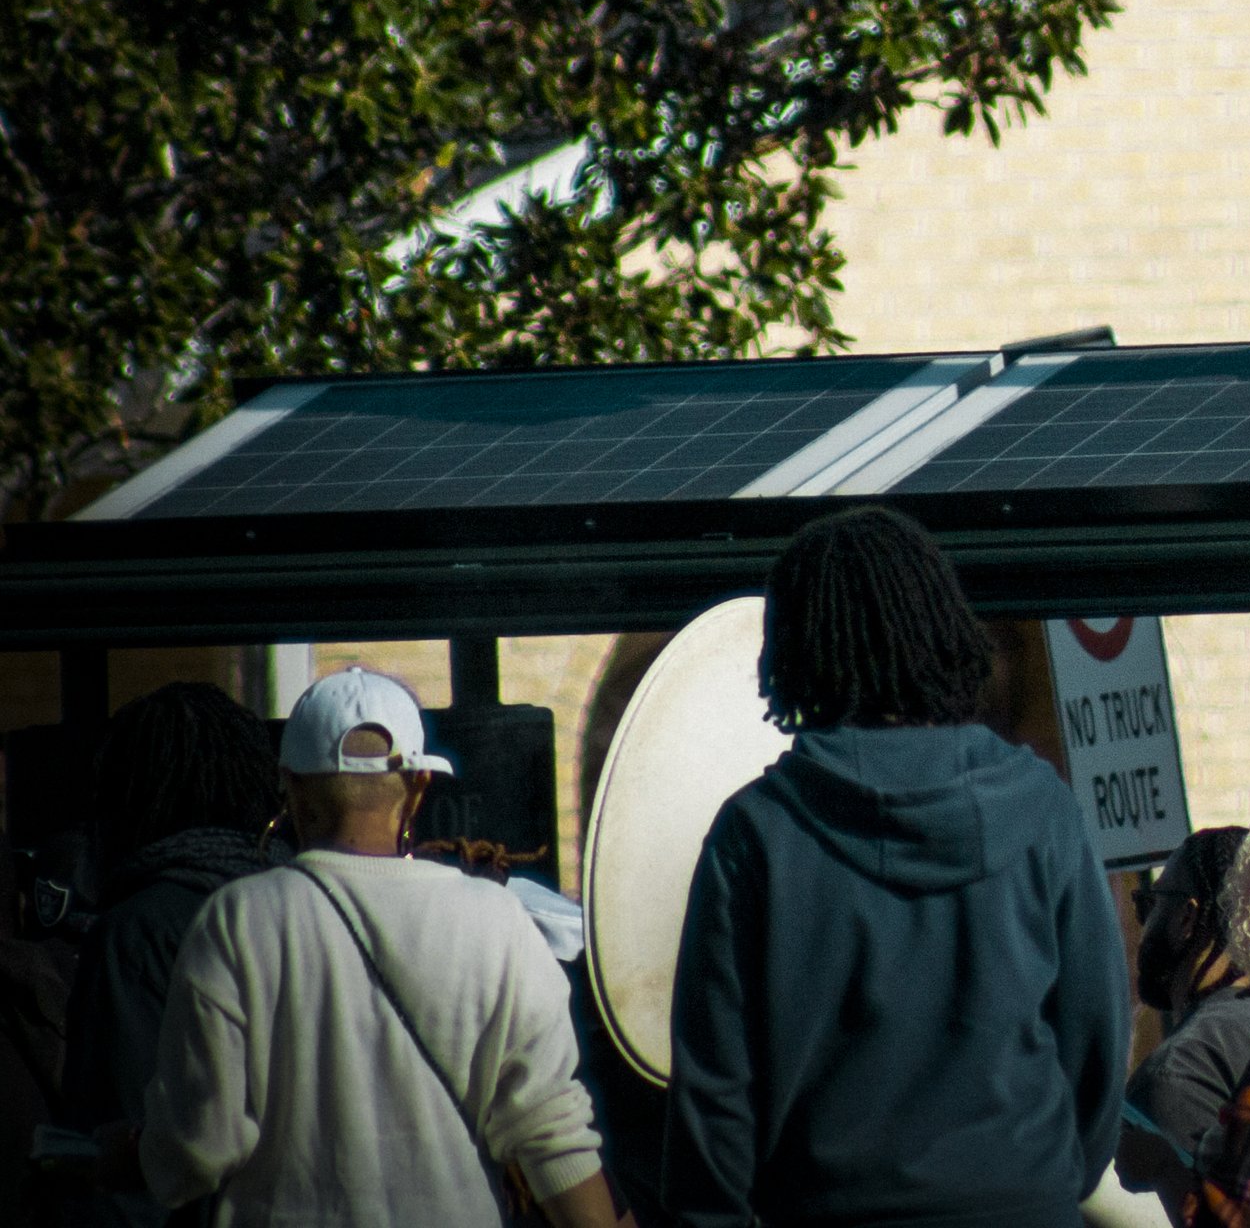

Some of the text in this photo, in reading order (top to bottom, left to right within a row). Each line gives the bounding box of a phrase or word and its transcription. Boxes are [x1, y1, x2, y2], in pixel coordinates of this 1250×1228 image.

[1065, 684, 1167, 749] NO TRUCK
[1092, 766, 1166, 830] ROUTE
